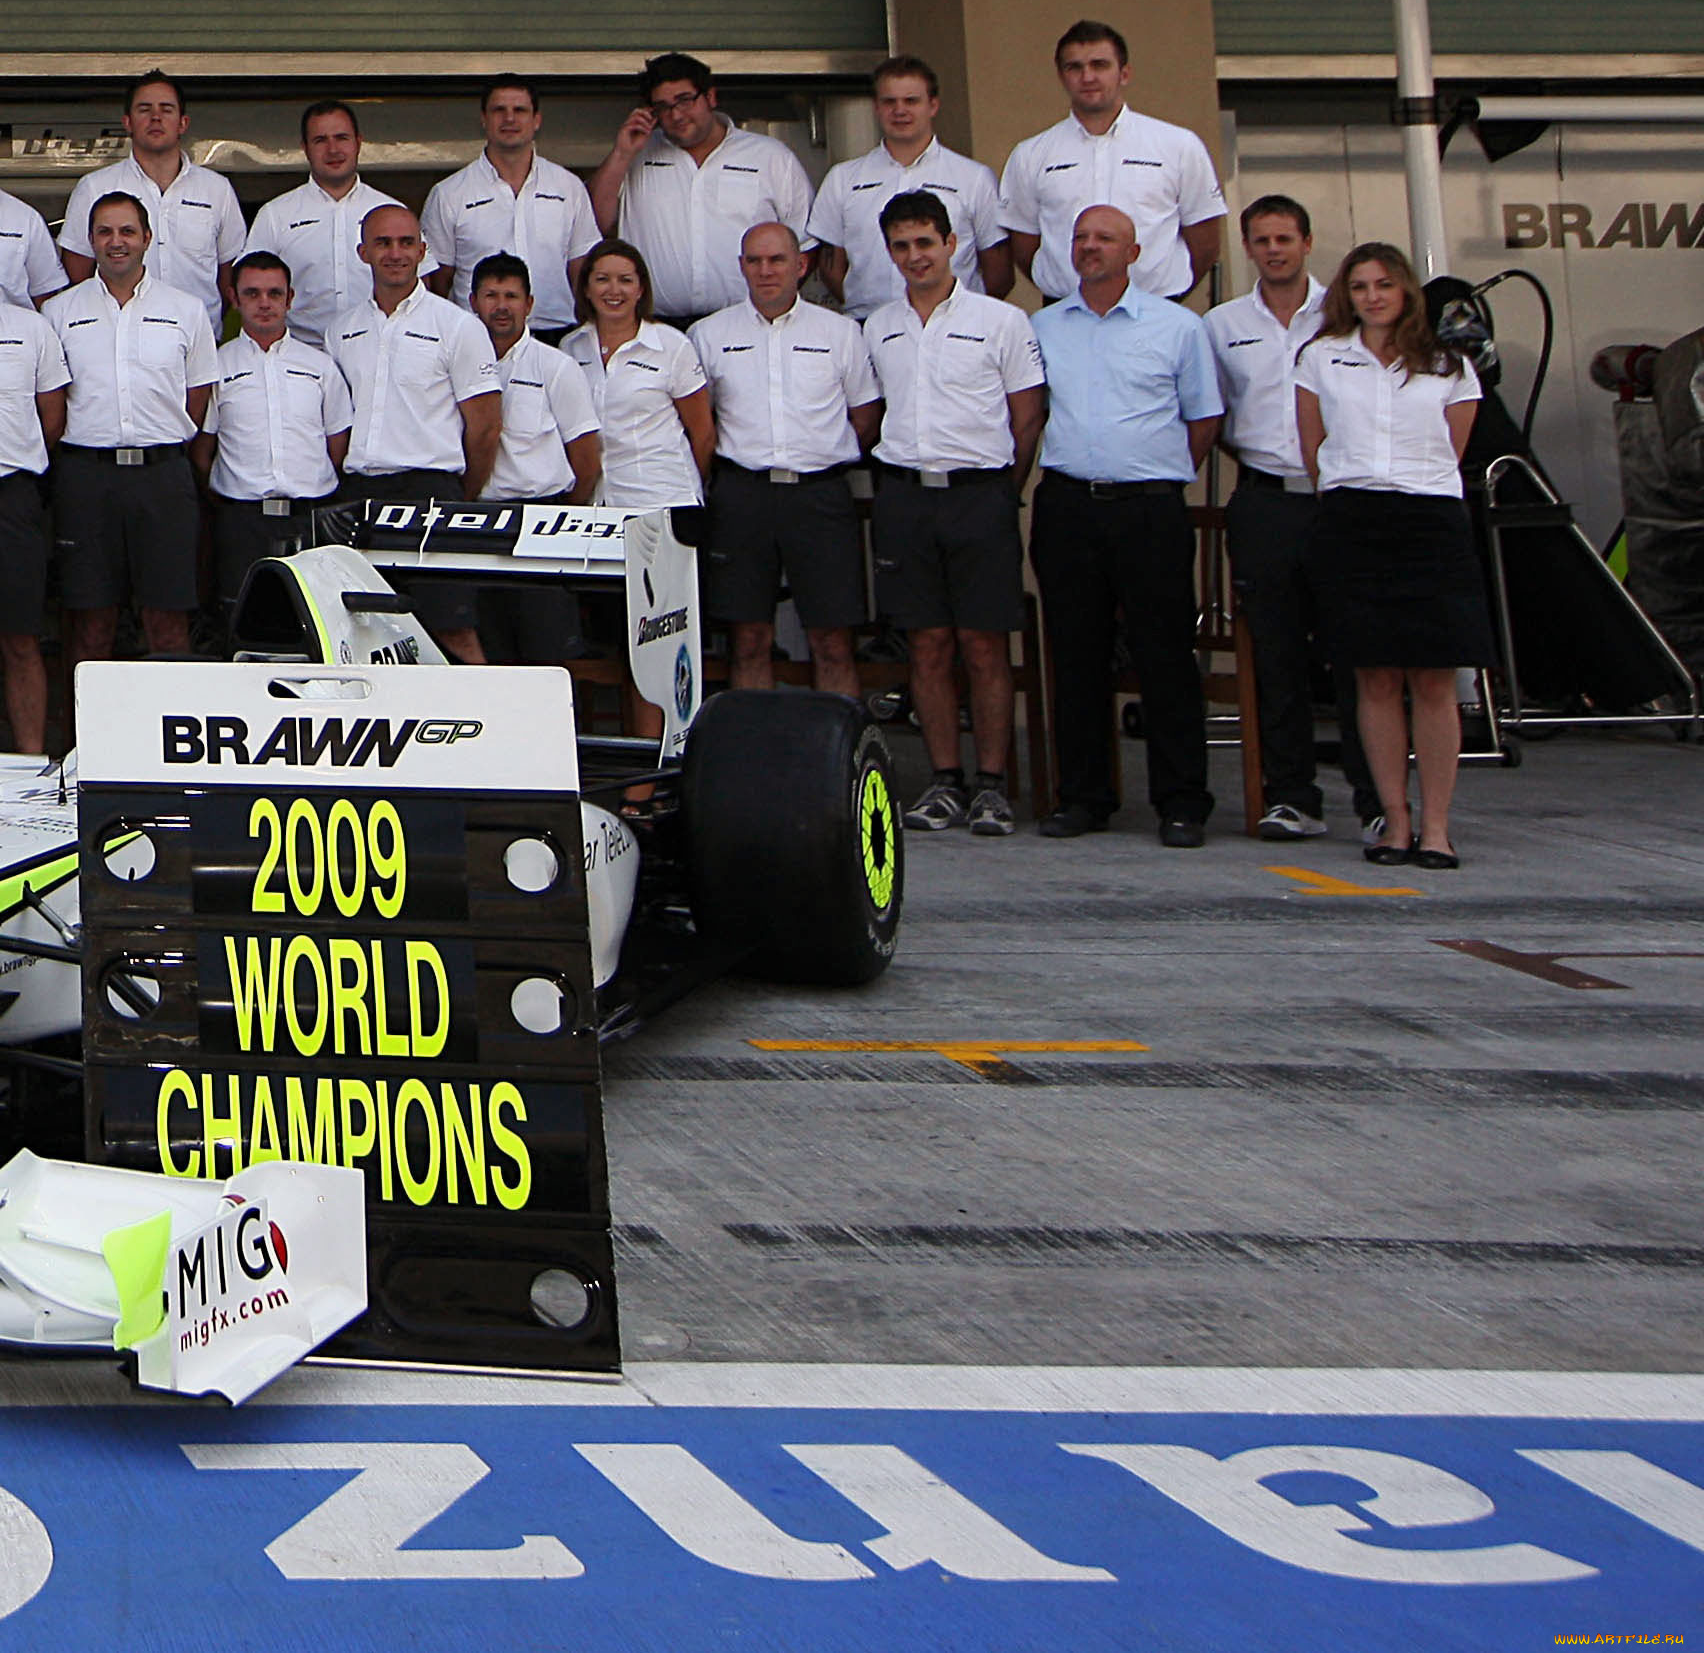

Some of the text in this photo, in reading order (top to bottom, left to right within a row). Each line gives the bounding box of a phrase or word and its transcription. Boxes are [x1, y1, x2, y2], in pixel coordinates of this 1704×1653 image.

[1502, 203, 1704, 249] BRAW
[374, 504, 516, 532] Qtel
[249, 798, 408, 918] 2009
[225, 935, 450, 1058] WORLD
[157, 1069, 533, 1210] CHAMPIONS
[178, 1206, 274, 1320] MIG
[180, 1287, 290, 1353] migfx.com
